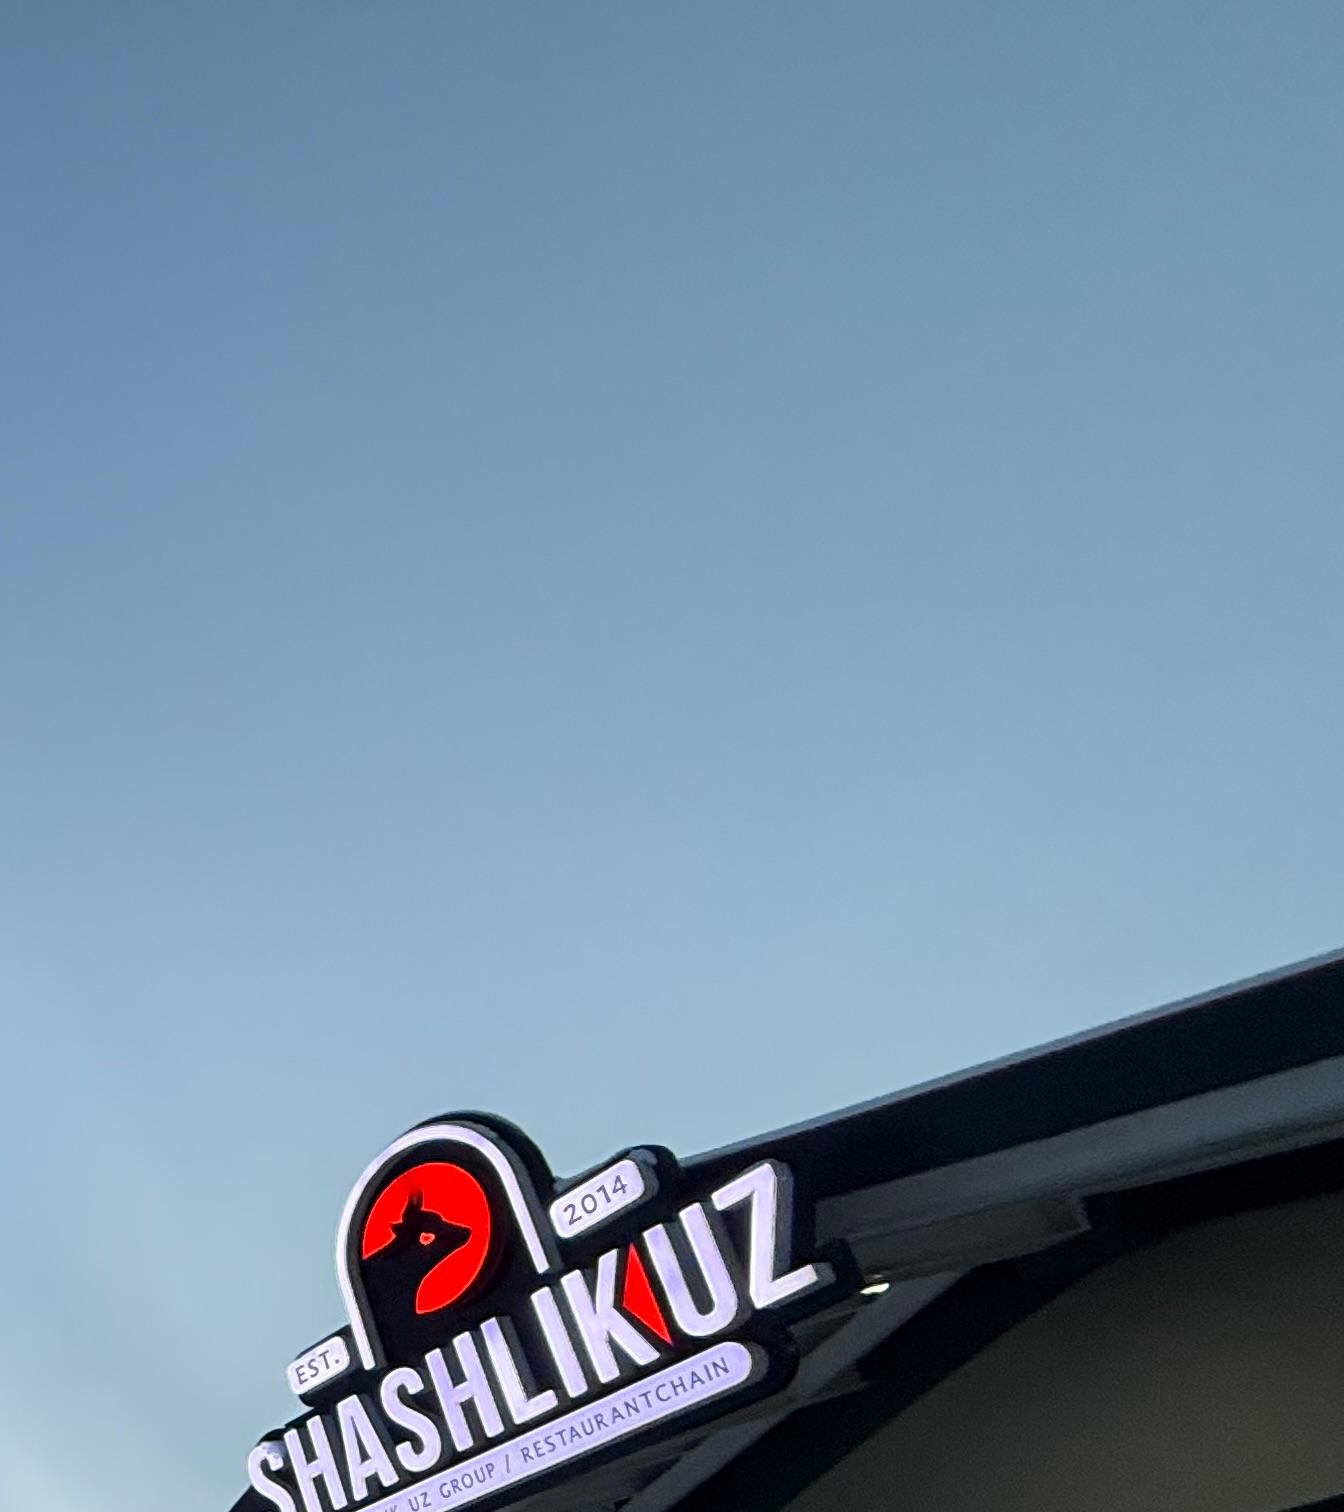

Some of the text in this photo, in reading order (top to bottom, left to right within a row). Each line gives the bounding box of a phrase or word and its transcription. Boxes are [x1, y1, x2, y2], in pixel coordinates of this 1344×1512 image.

[562, 1174, 628, 1226] 2014
[295, 1349, 340, 1385] EST.
[408, 1491, 433, 1512] UZ
[438, 1461, 496, 1499] GROUP
